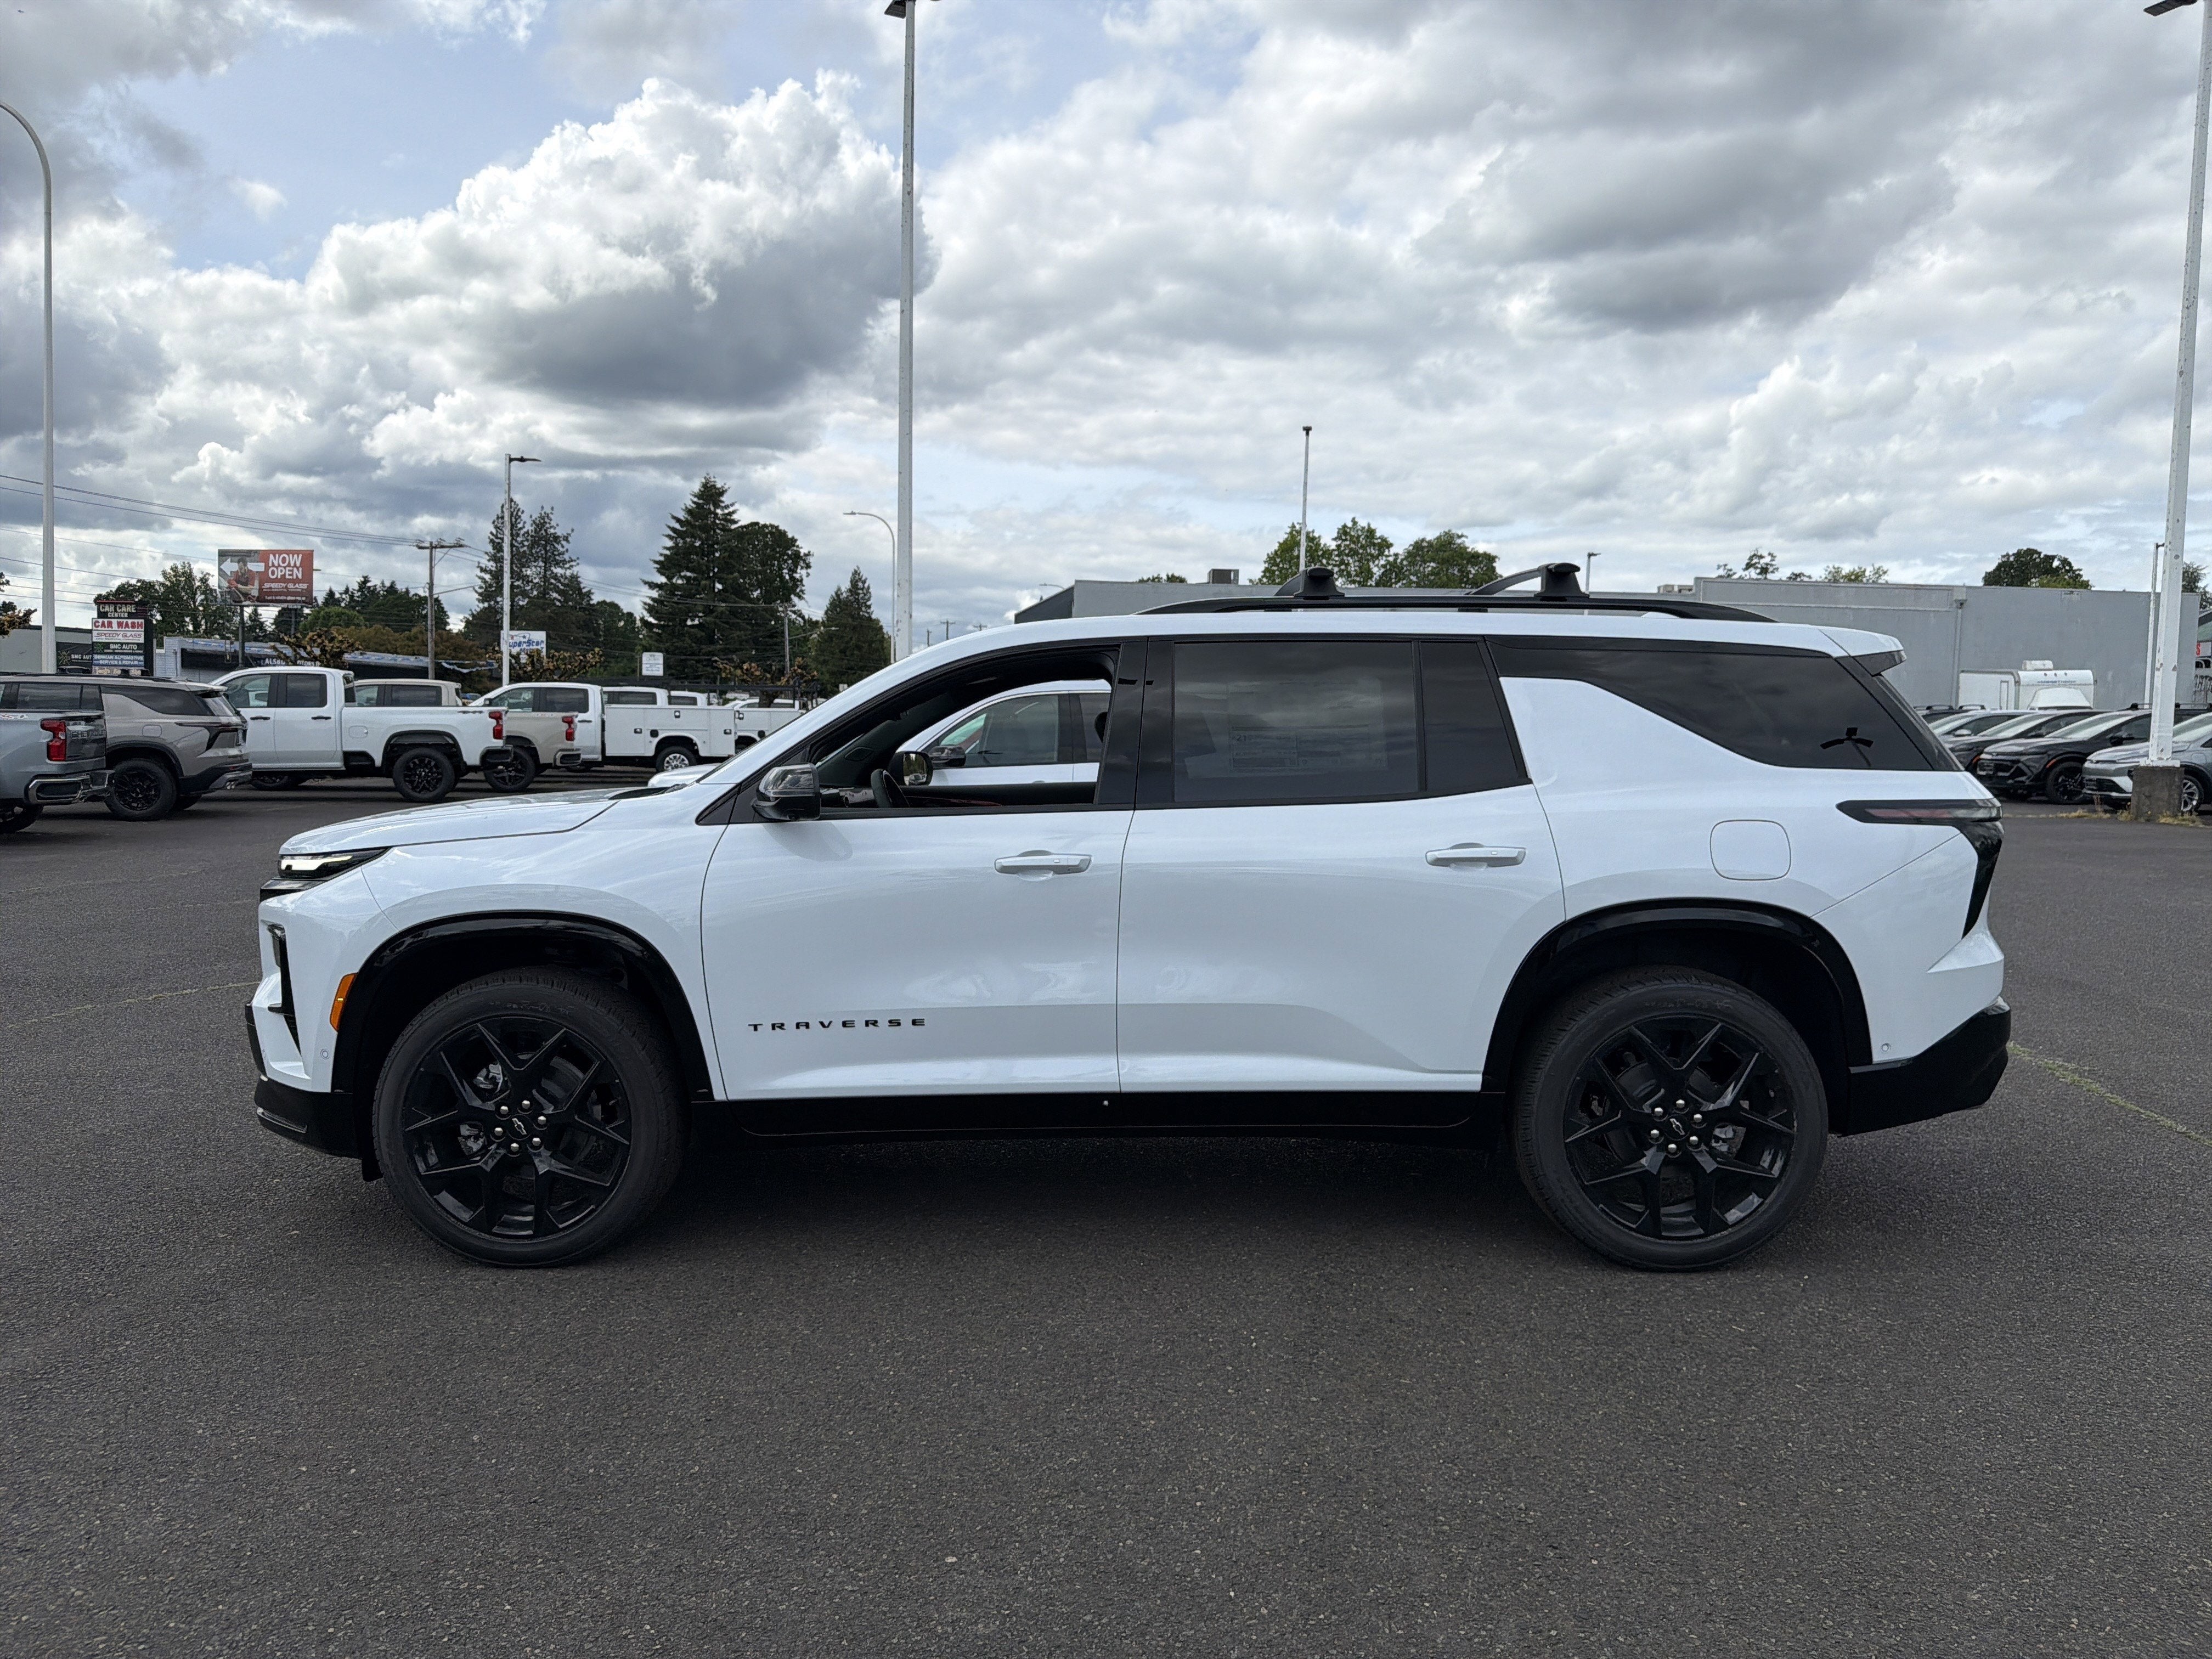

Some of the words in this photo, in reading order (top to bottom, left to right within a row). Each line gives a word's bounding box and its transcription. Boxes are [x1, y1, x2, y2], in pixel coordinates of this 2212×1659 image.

[269, 554, 302, 567] NOW
[268, 567, 302, 579] OPEN
[99, 604, 114, 612] CAR
[116, 604, 136, 613] CARE
[93, 620, 114, 629] CAR
[116, 620, 143, 629] WASH
[509, 639, 544, 649] uperStar
[748, 1018, 925, 1031] TRAVERSE
